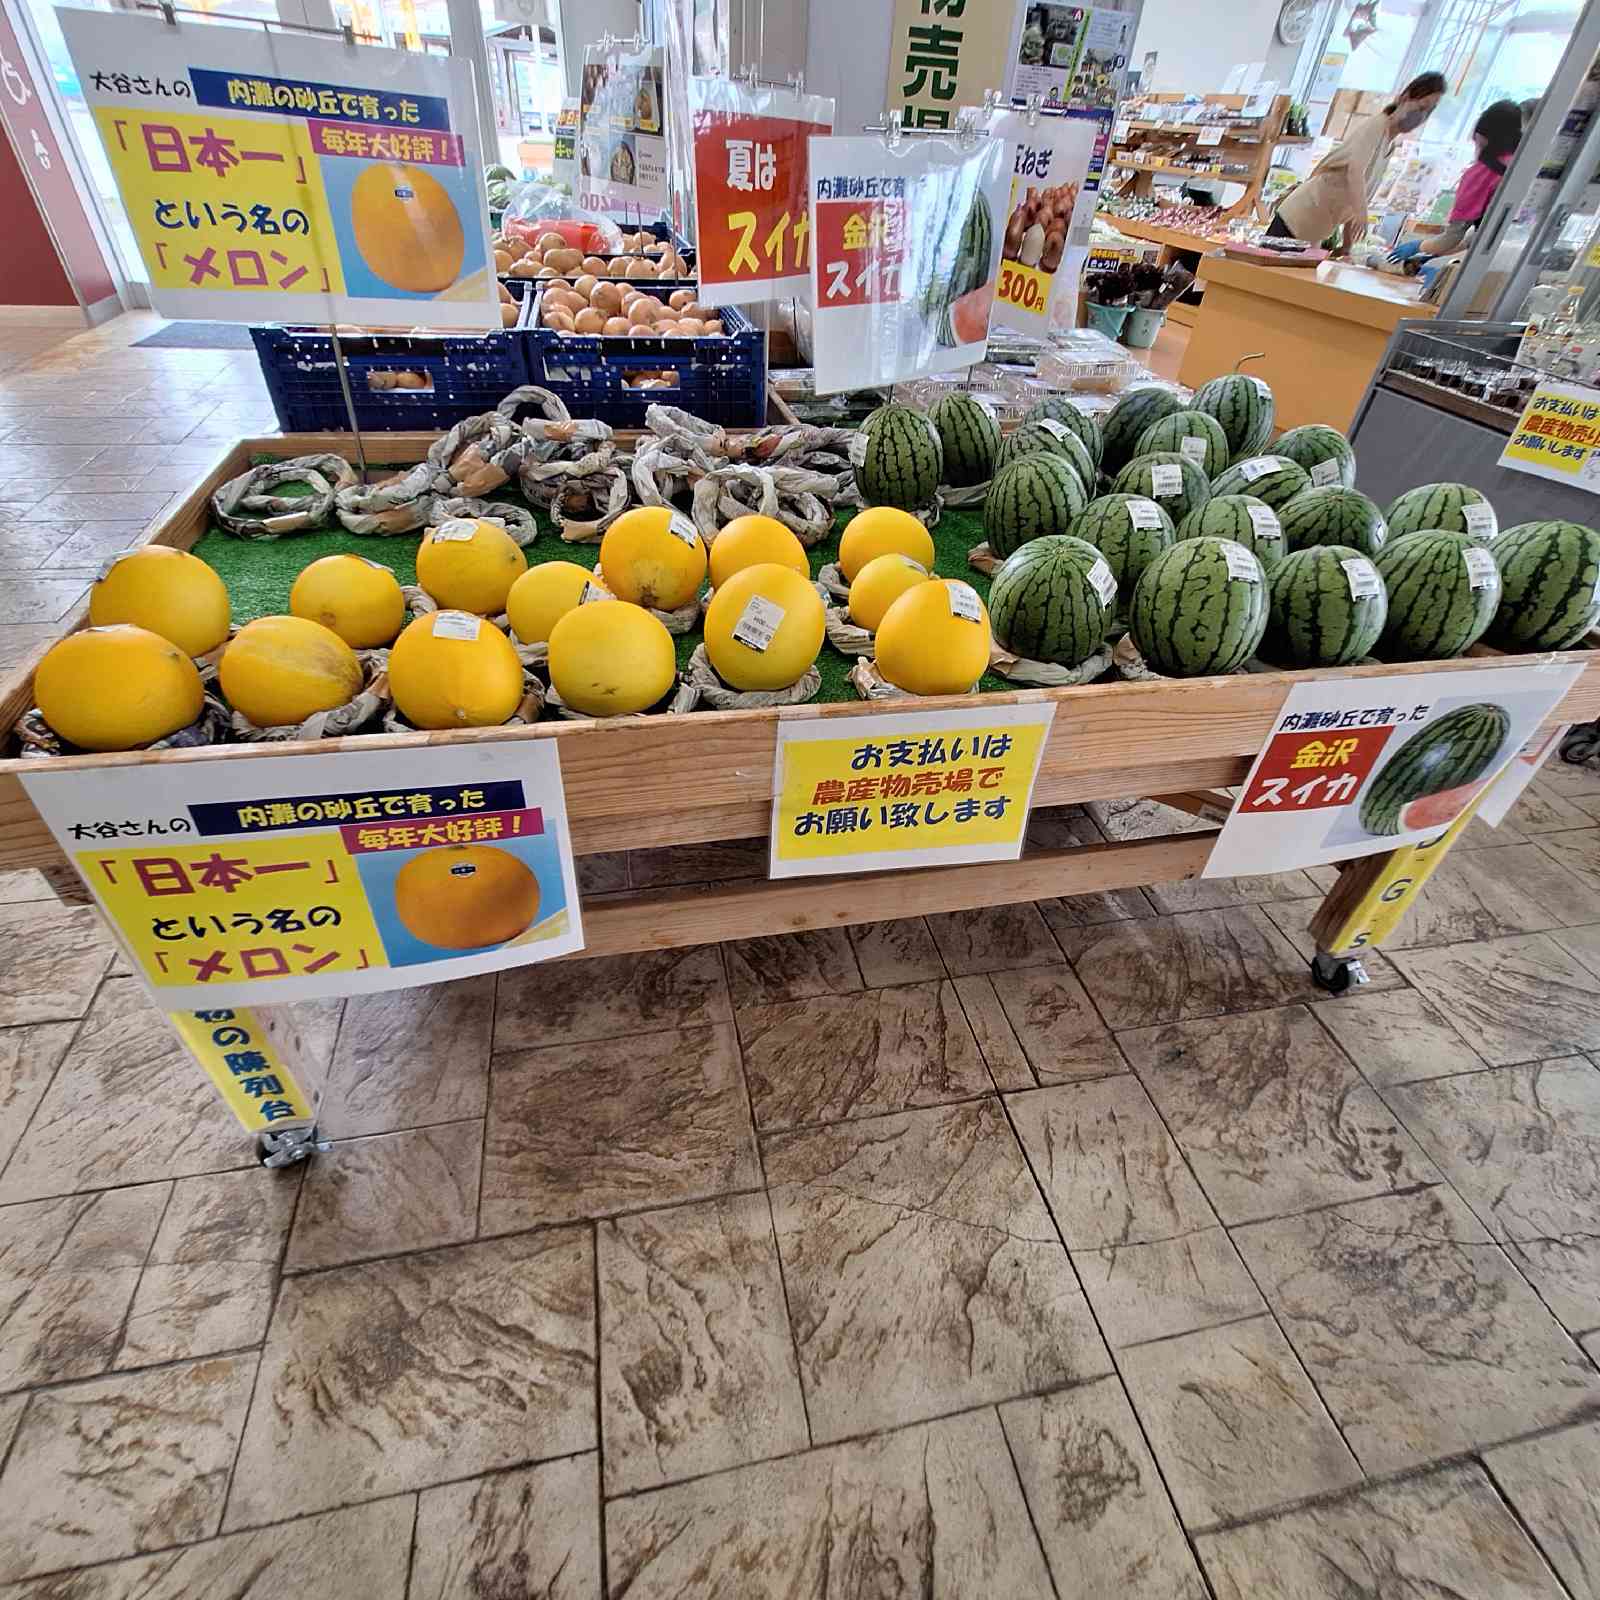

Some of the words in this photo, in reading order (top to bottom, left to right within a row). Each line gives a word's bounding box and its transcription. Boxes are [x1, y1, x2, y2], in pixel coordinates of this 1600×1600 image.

[89, 72, 191, 99] 大谷さんの
[227, 79, 420, 124] 内灘の砂丘で育った
[114, 120, 308, 185] 「日本一」
[725, 139, 777, 192] 夏は
[154, 200, 311, 237] という名の
[155, 243, 331, 294] 「メロン」
[998, 269, 1046, 313] 300円
[1534, 396, 1600, 420] お支払いは
[1514, 432, 1588, 461] お願いします
[1278, 704, 1429, 731] 内灘砂丘で育った
[851, 733, 1013, 770] お支払いは
[1290, 737, 1360, 770] 金沢
[811, 766, 1006, 805] 農産物売場で
[1251, 773, 1359, 808] スイカ
[238, 789, 486, 830] 内灘の砂丘で育った
[793, 796, 1011, 836] お願い致します
[67, 817, 192, 841] 大谷さんの
[100, 852, 340, 898] 「日本一」
[151, 906, 342, 940] という名の
[151, 943, 371, 983] 「メロン」
